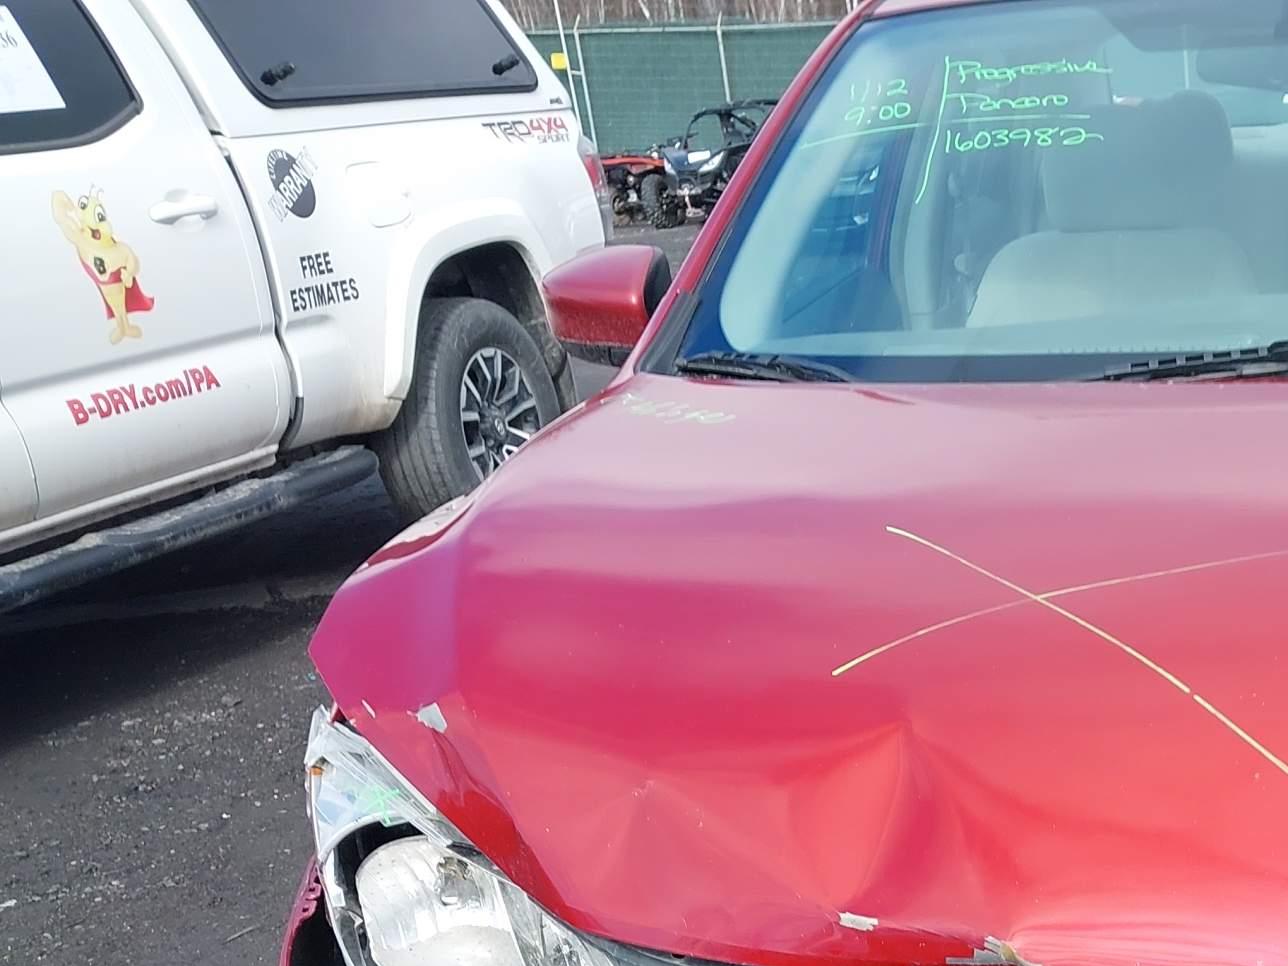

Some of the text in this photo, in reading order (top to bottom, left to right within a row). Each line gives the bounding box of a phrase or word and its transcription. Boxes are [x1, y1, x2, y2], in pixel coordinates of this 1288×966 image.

[844, 102, 911, 125] 9:00
[481, 120, 531, 143] TRD
[946, 126, 1104, 153] 1603982
[299, 252, 334, 279] FREE
[289, 278, 360, 313] ESTIMATES
[66, 365, 221, 426] B-DRY.com/PA
